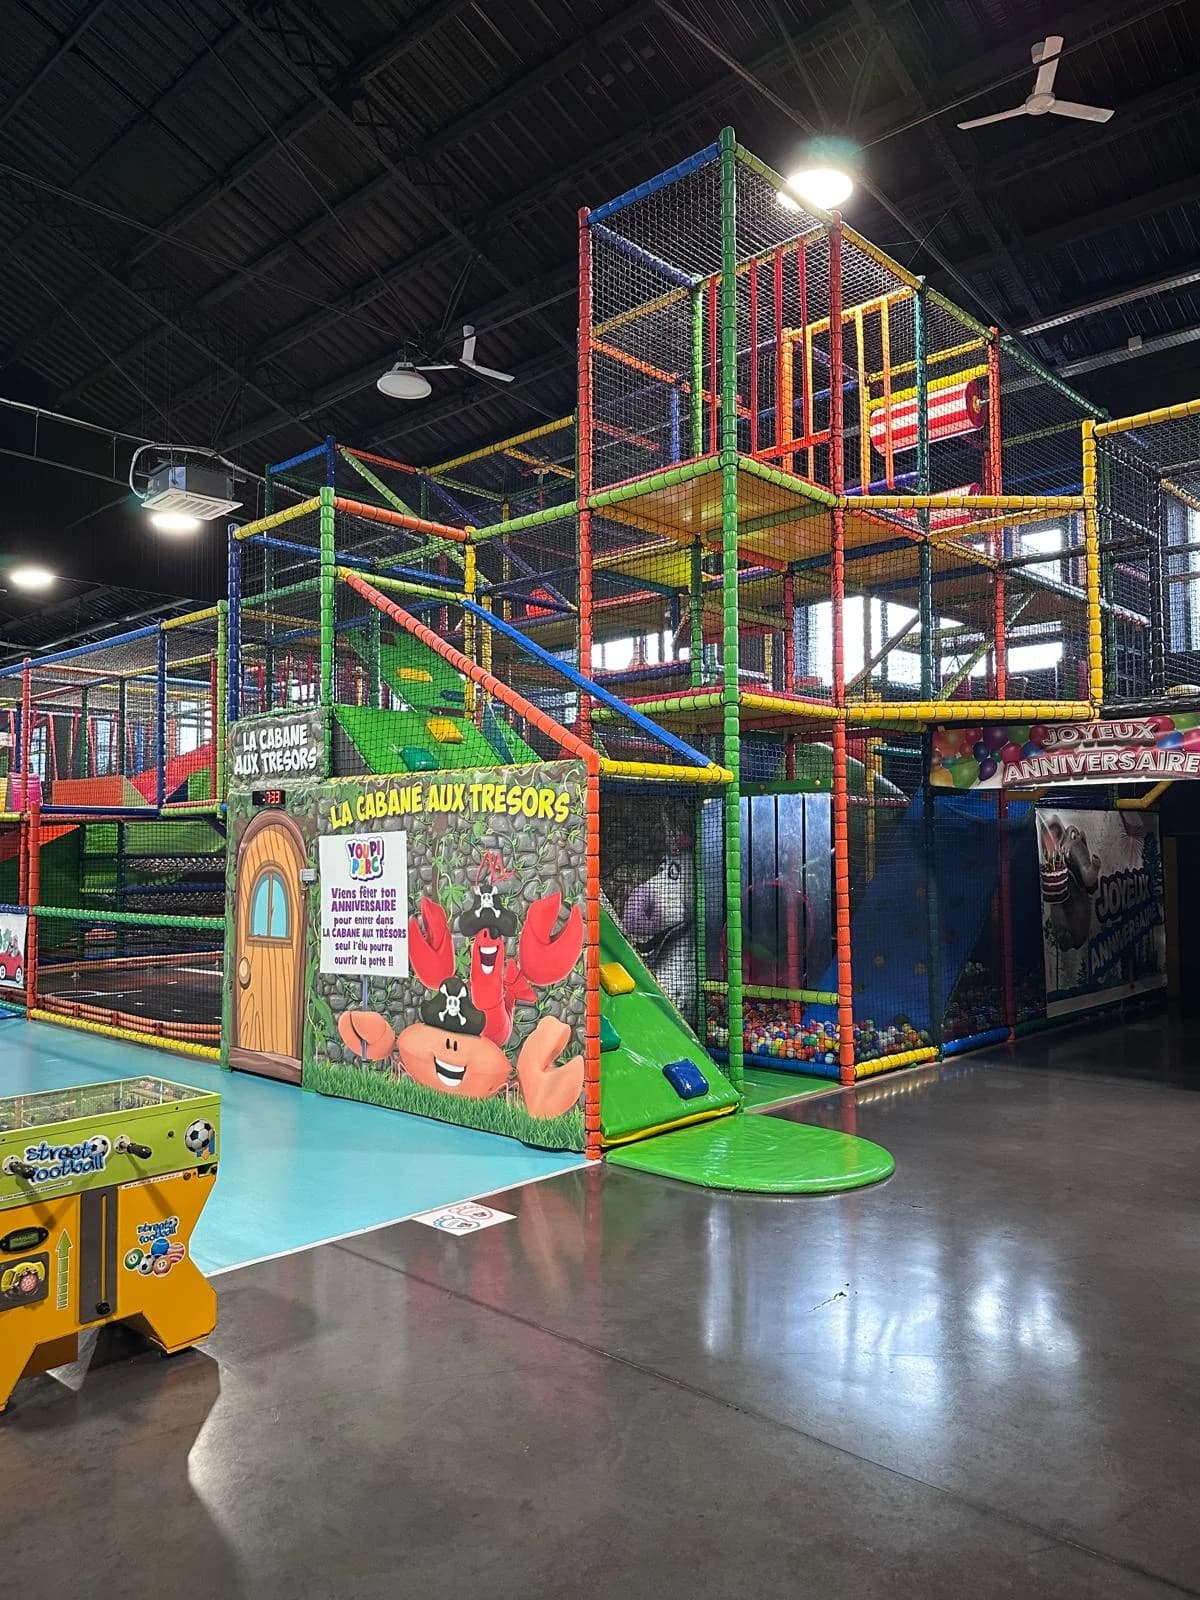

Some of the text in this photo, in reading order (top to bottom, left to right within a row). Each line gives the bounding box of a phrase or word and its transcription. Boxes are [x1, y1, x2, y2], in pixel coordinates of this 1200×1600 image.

[243, 724, 308, 752] LA CABANE
[1042, 722, 1157, 746] JOYEUX
[234, 746, 317, 775] AUX TRESORS
[1004, 750, 1200, 783] ANNIVERSAIRE
[329, 783, 571, 830] LA CABANE AUX TRESORS
[347, 840, 381, 859] YOUPI
[351, 856, 380, 876] PARC
[331, 885, 397, 899] Viens fêter ton
[1098, 873, 1151, 918] JOYEUX
[331, 899, 397, 912] ANNIVERSAIRE
[333, 914, 394, 928] pour entrer dans
[322, 926, 407, 939] LA CABANE AUX TRÉSORS
[335, 940, 393, 954] seul l'élu pourra
[334, 955, 358, 965] ouvrir
[360, 955, 367, 965] la
[369, 956, 386, 968] porte
[25, 1141, 92, 1161] street
